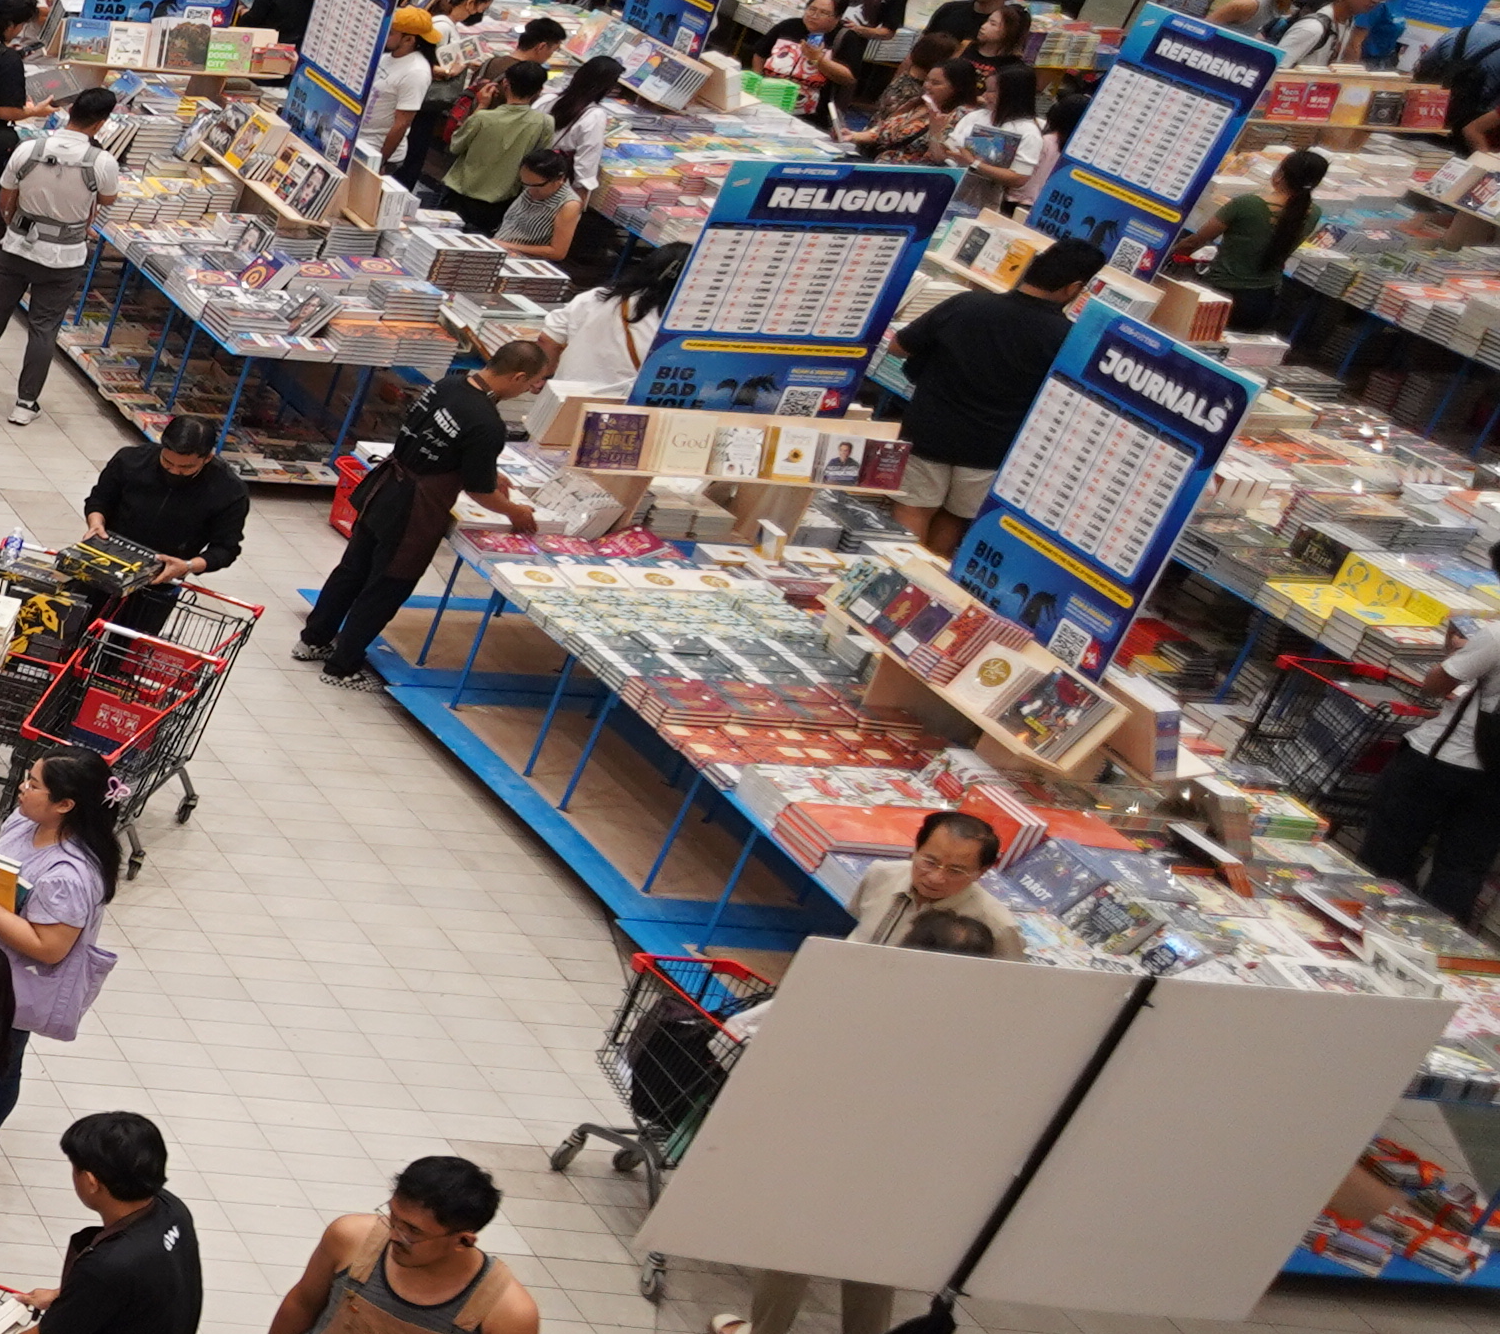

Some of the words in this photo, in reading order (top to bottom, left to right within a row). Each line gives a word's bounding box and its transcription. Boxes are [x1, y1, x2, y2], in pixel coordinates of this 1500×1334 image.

[94, 4, 127, 15] BAD
[1155, 37, 1259, 88] REFERENCE
[766, 186, 926, 214] RELIGION
[656, 367, 695, 380] BIG
[648, 383, 697, 397] BAD
[1099, 349, 1228, 433] JOURNALS
[602, 434, 637, 447] BIBLE
[672, 433, 711, 450] God
[1019, 874, 1052, 901] TAROT
